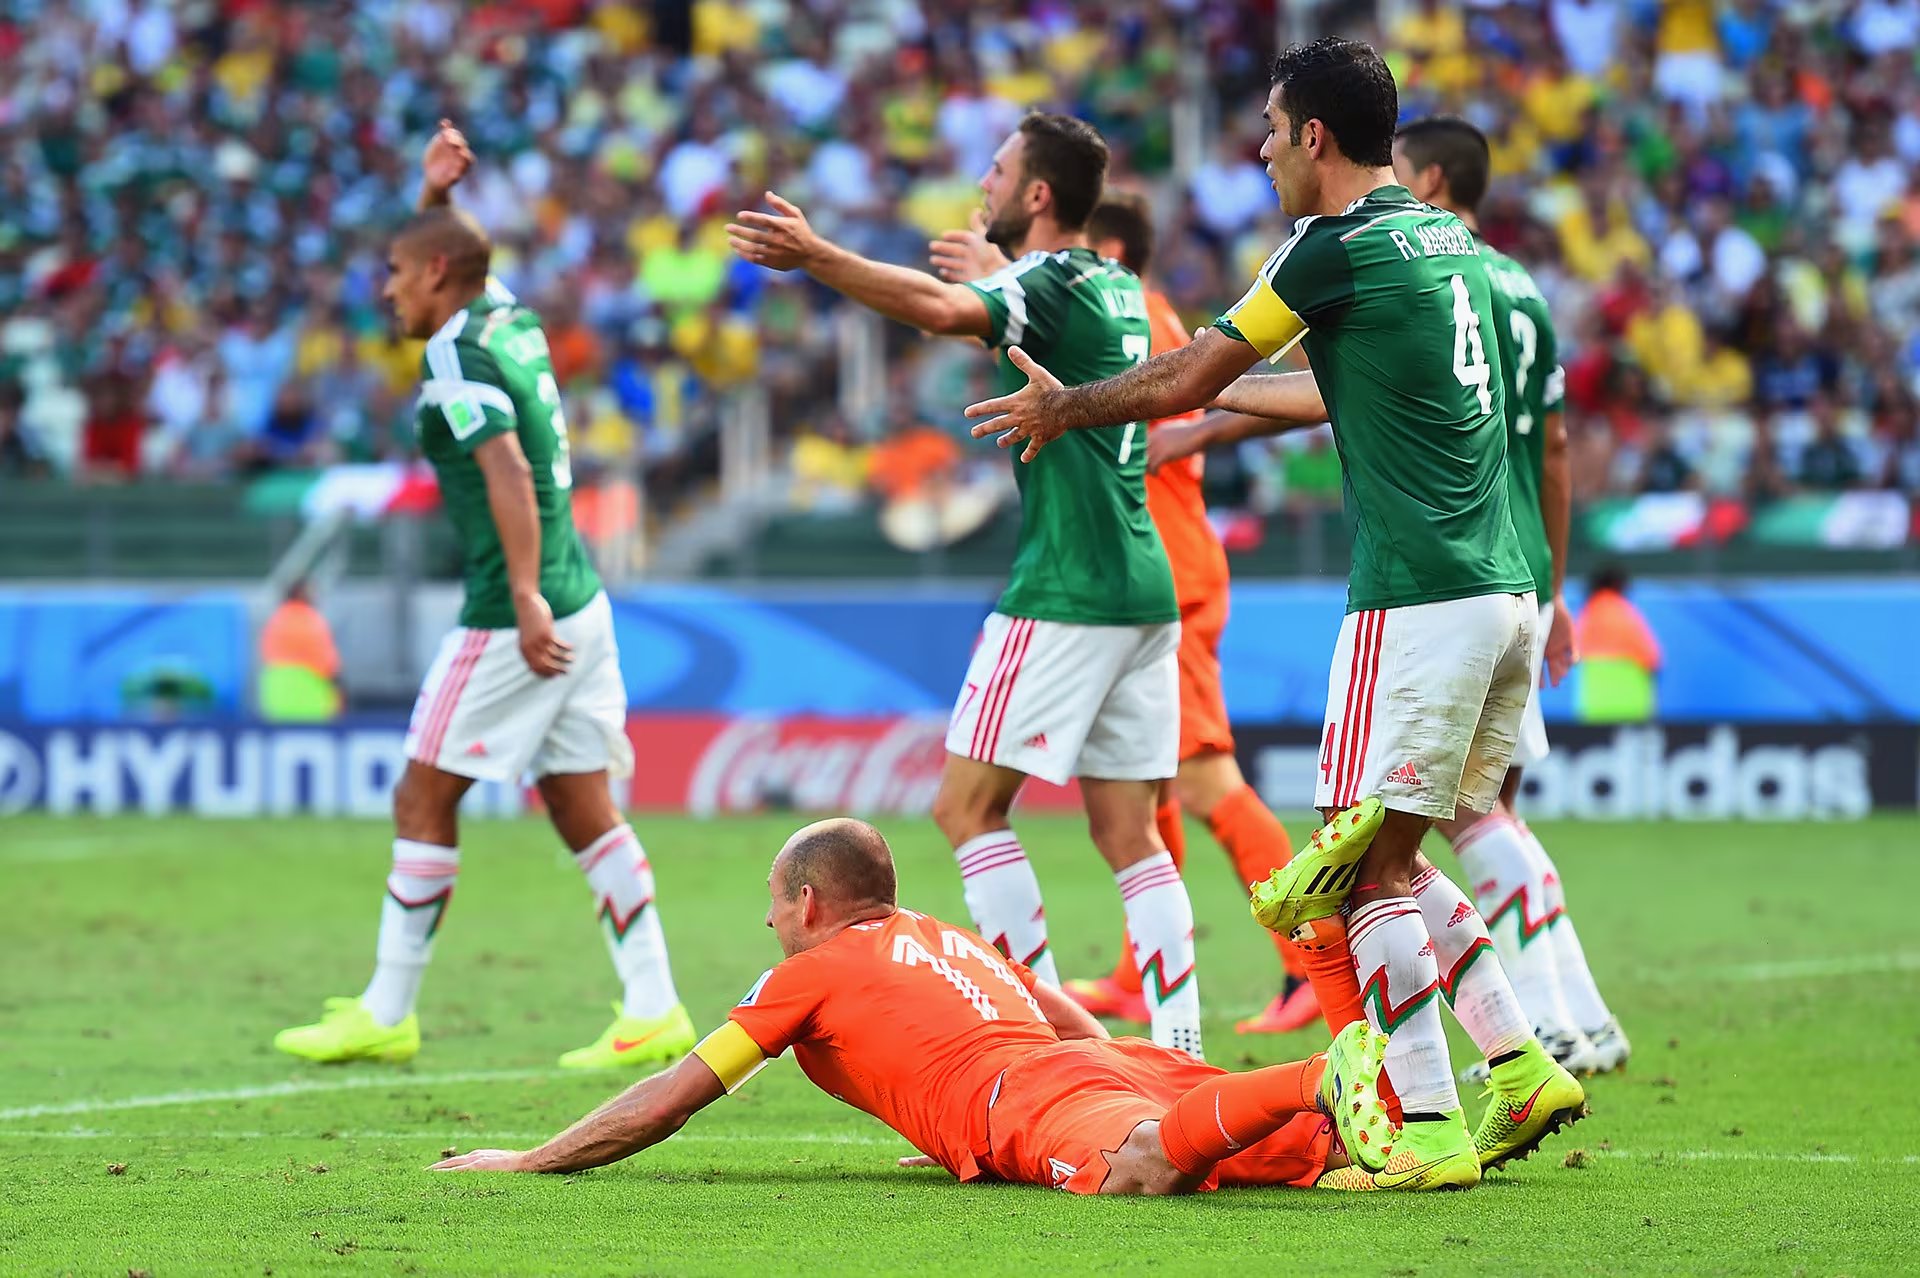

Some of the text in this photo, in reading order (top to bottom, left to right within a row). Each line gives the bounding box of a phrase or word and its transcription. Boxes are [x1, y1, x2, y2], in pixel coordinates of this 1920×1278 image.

[1388, 230, 1420, 261] R.
[1450, 274, 1492, 414] 4
[46, 730, 526, 818] HYUND
[1321, 722, 1336, 784] 4
[1386, 775, 1422, 785] adidas
[1521, 723, 1872, 821] adidas
[891, 930, 1048, 1022] 11
